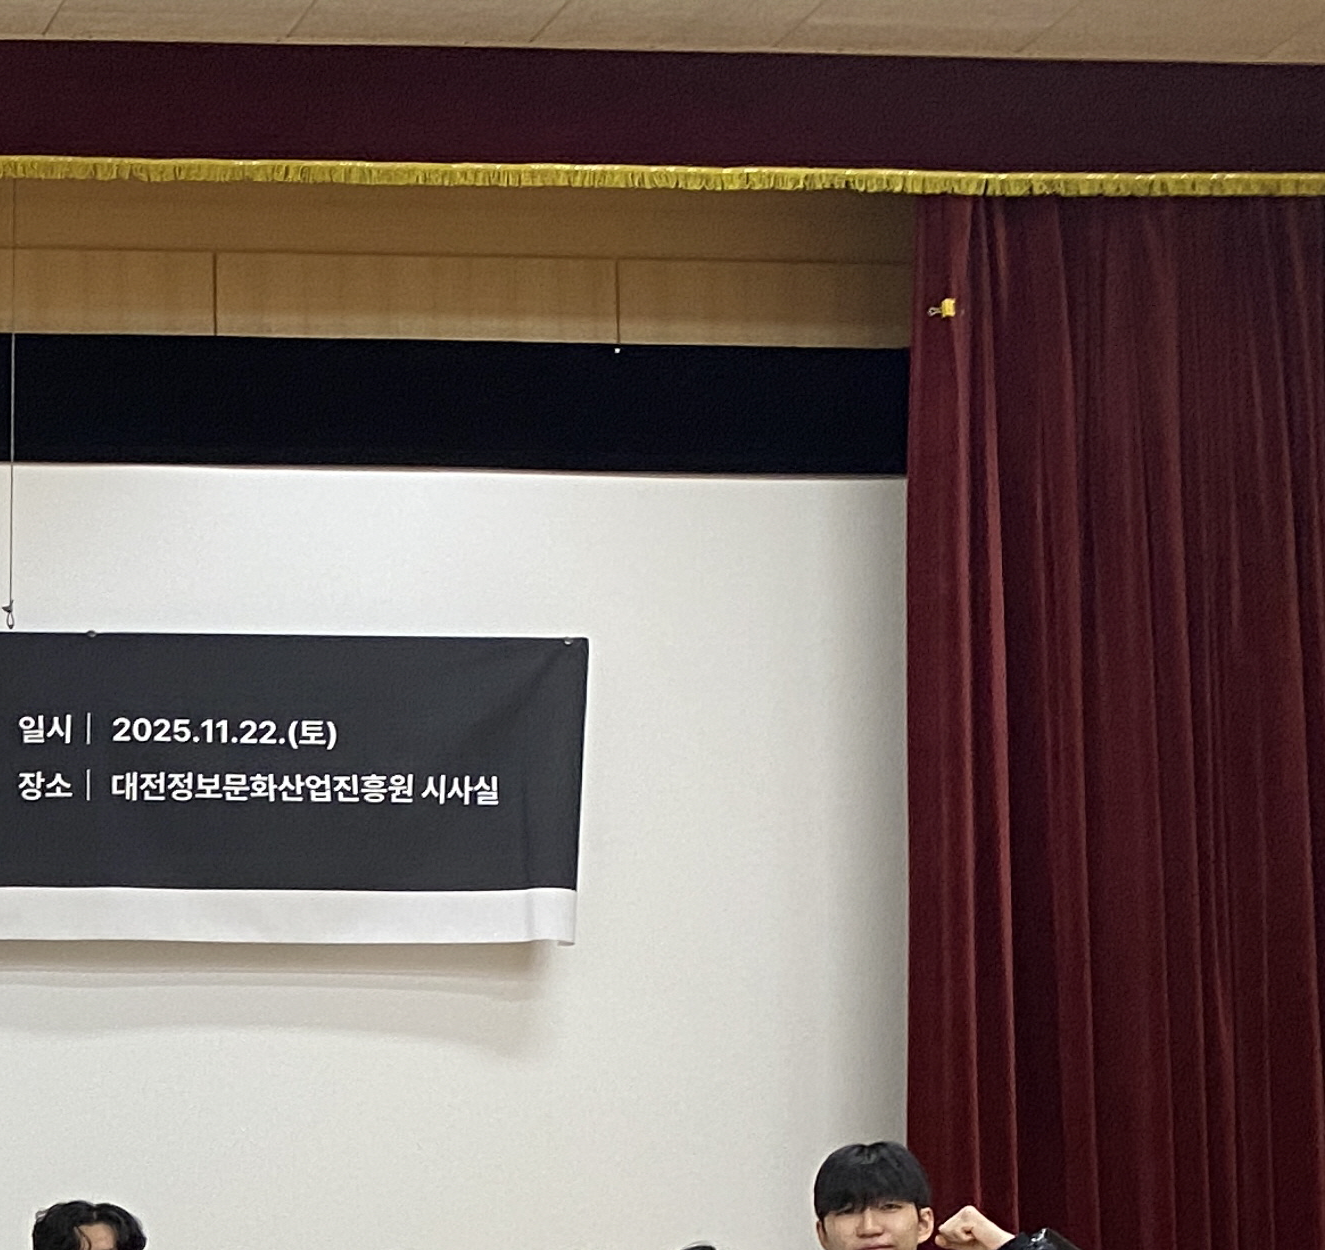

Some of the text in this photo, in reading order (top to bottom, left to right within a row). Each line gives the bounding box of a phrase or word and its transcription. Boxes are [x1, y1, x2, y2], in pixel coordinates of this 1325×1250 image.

[19, 715, 336, 750] 일시 2025.11.22.(토)
[19, 771, 498, 805] 장소 대전정보문화산업진흥원 시사실
